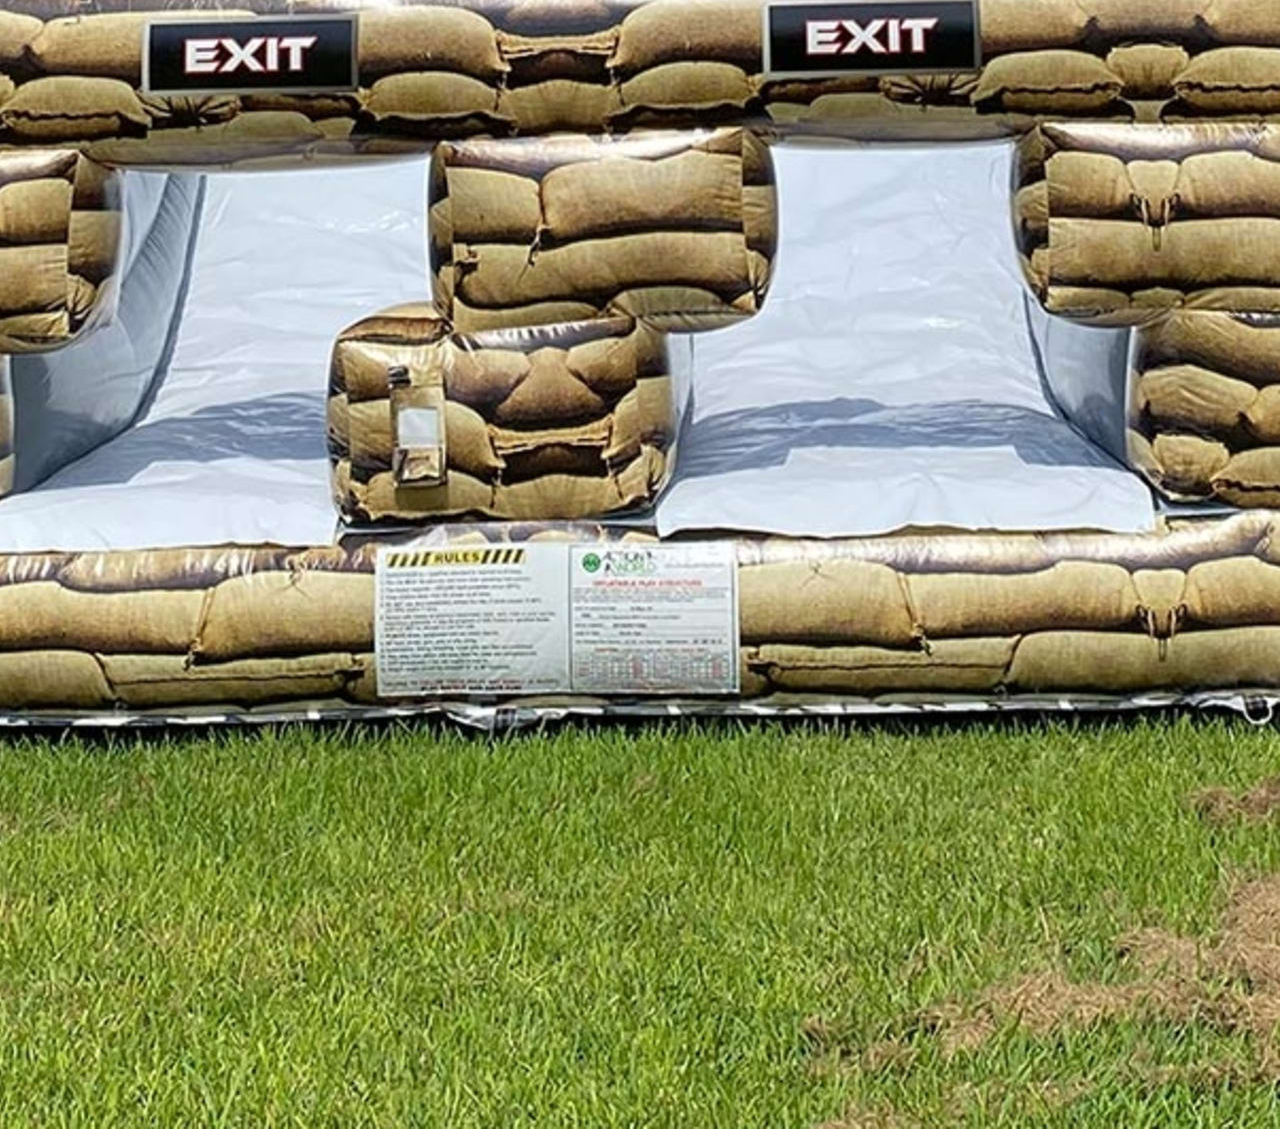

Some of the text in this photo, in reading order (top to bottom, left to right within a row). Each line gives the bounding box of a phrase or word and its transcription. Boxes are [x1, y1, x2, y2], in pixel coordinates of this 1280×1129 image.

[184, 35, 318, 74] EXIT
[805, 17, 939, 55] EXIT
[433, 551, 480, 564] RULES
